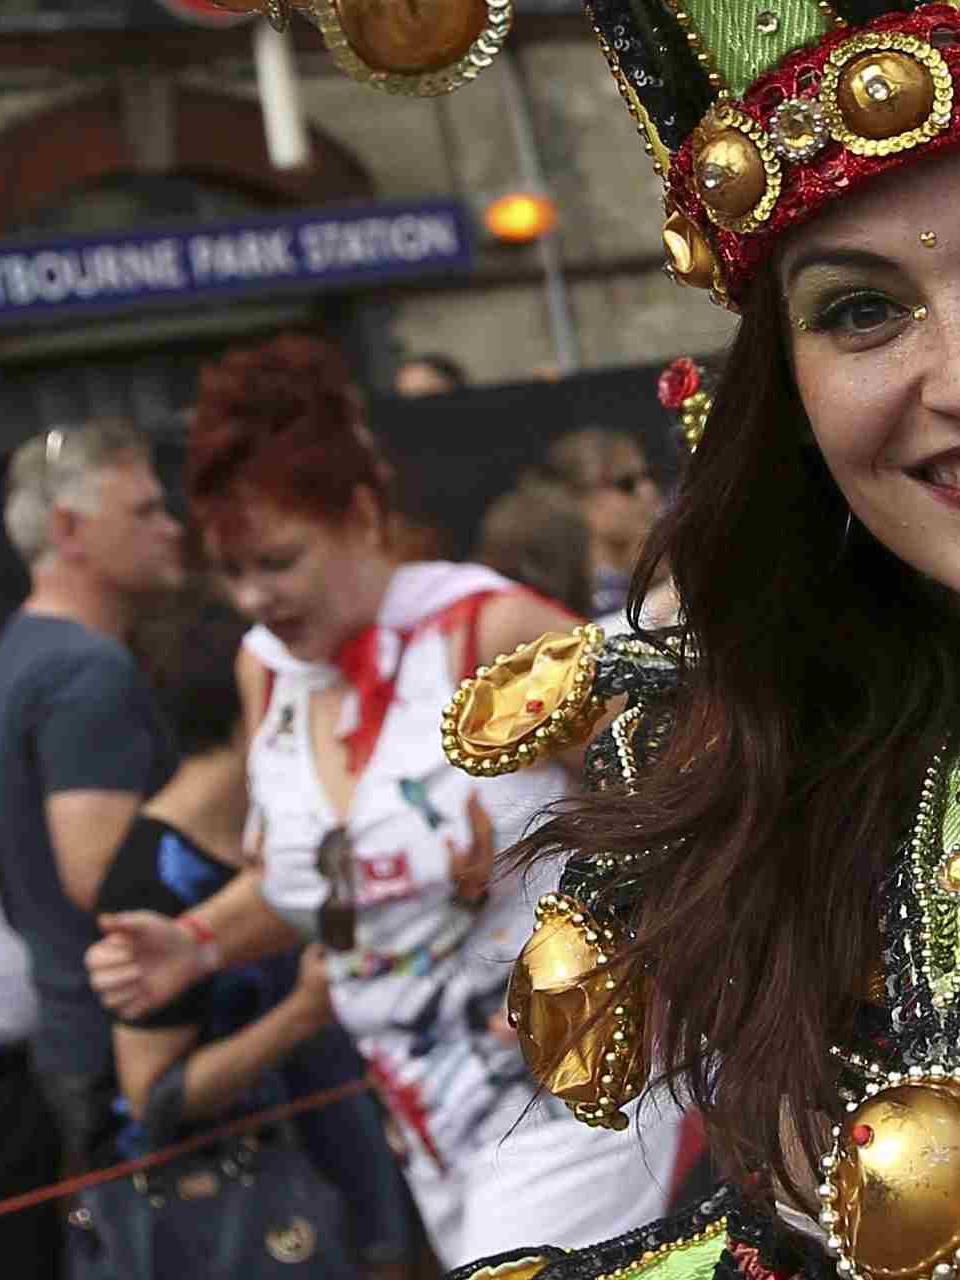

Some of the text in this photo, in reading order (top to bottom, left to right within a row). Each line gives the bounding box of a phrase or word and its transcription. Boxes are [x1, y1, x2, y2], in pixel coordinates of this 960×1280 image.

[0, 213, 459, 305] BOURNE PARK STATION
